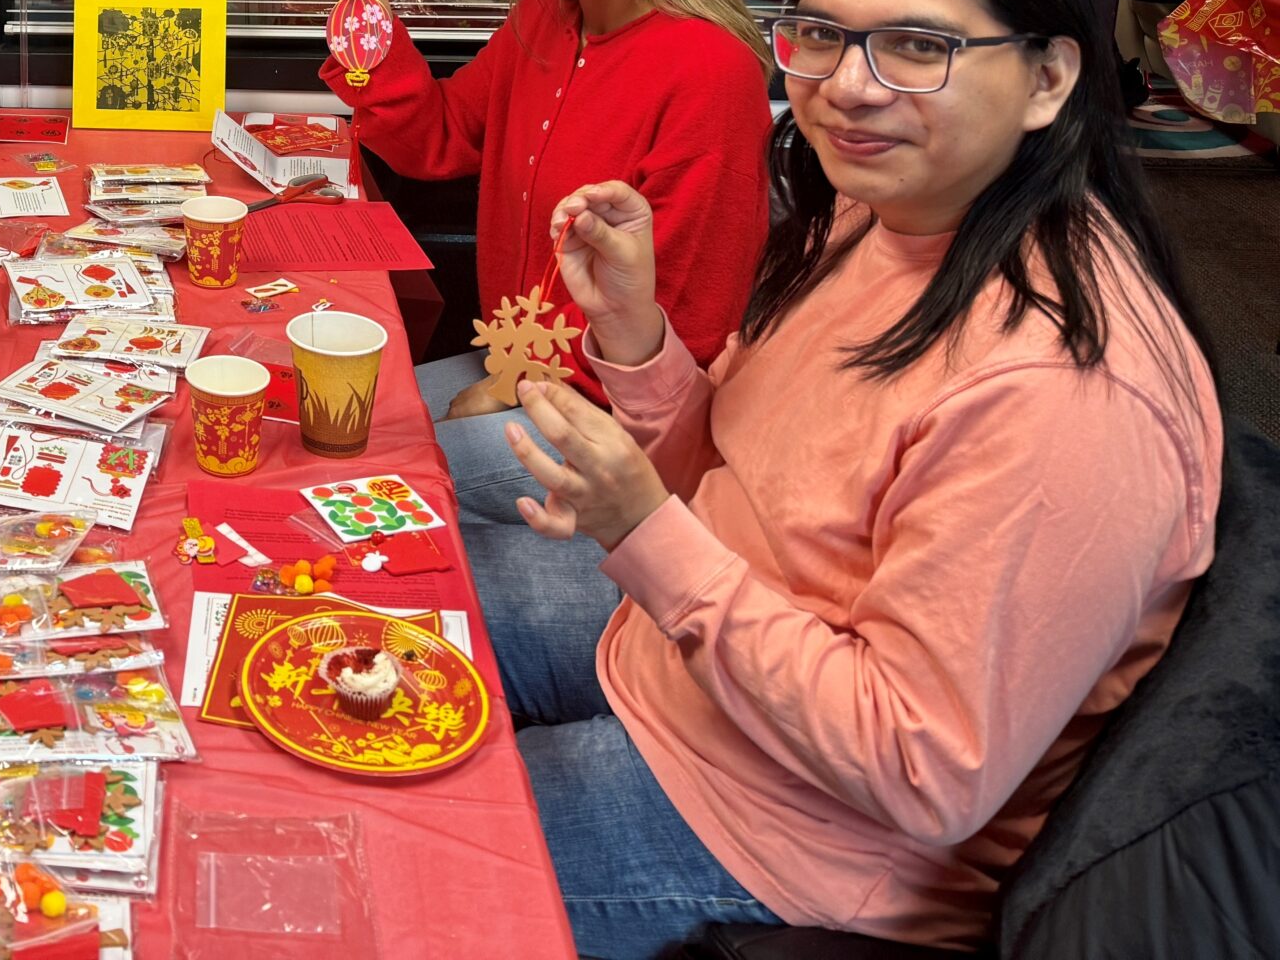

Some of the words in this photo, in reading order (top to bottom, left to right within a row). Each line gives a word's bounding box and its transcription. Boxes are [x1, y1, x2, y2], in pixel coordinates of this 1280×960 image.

[291, 701, 321, 716] HAPPY
[366, 719, 390, 732] NEW
[392, 724, 418, 740] YEAR
